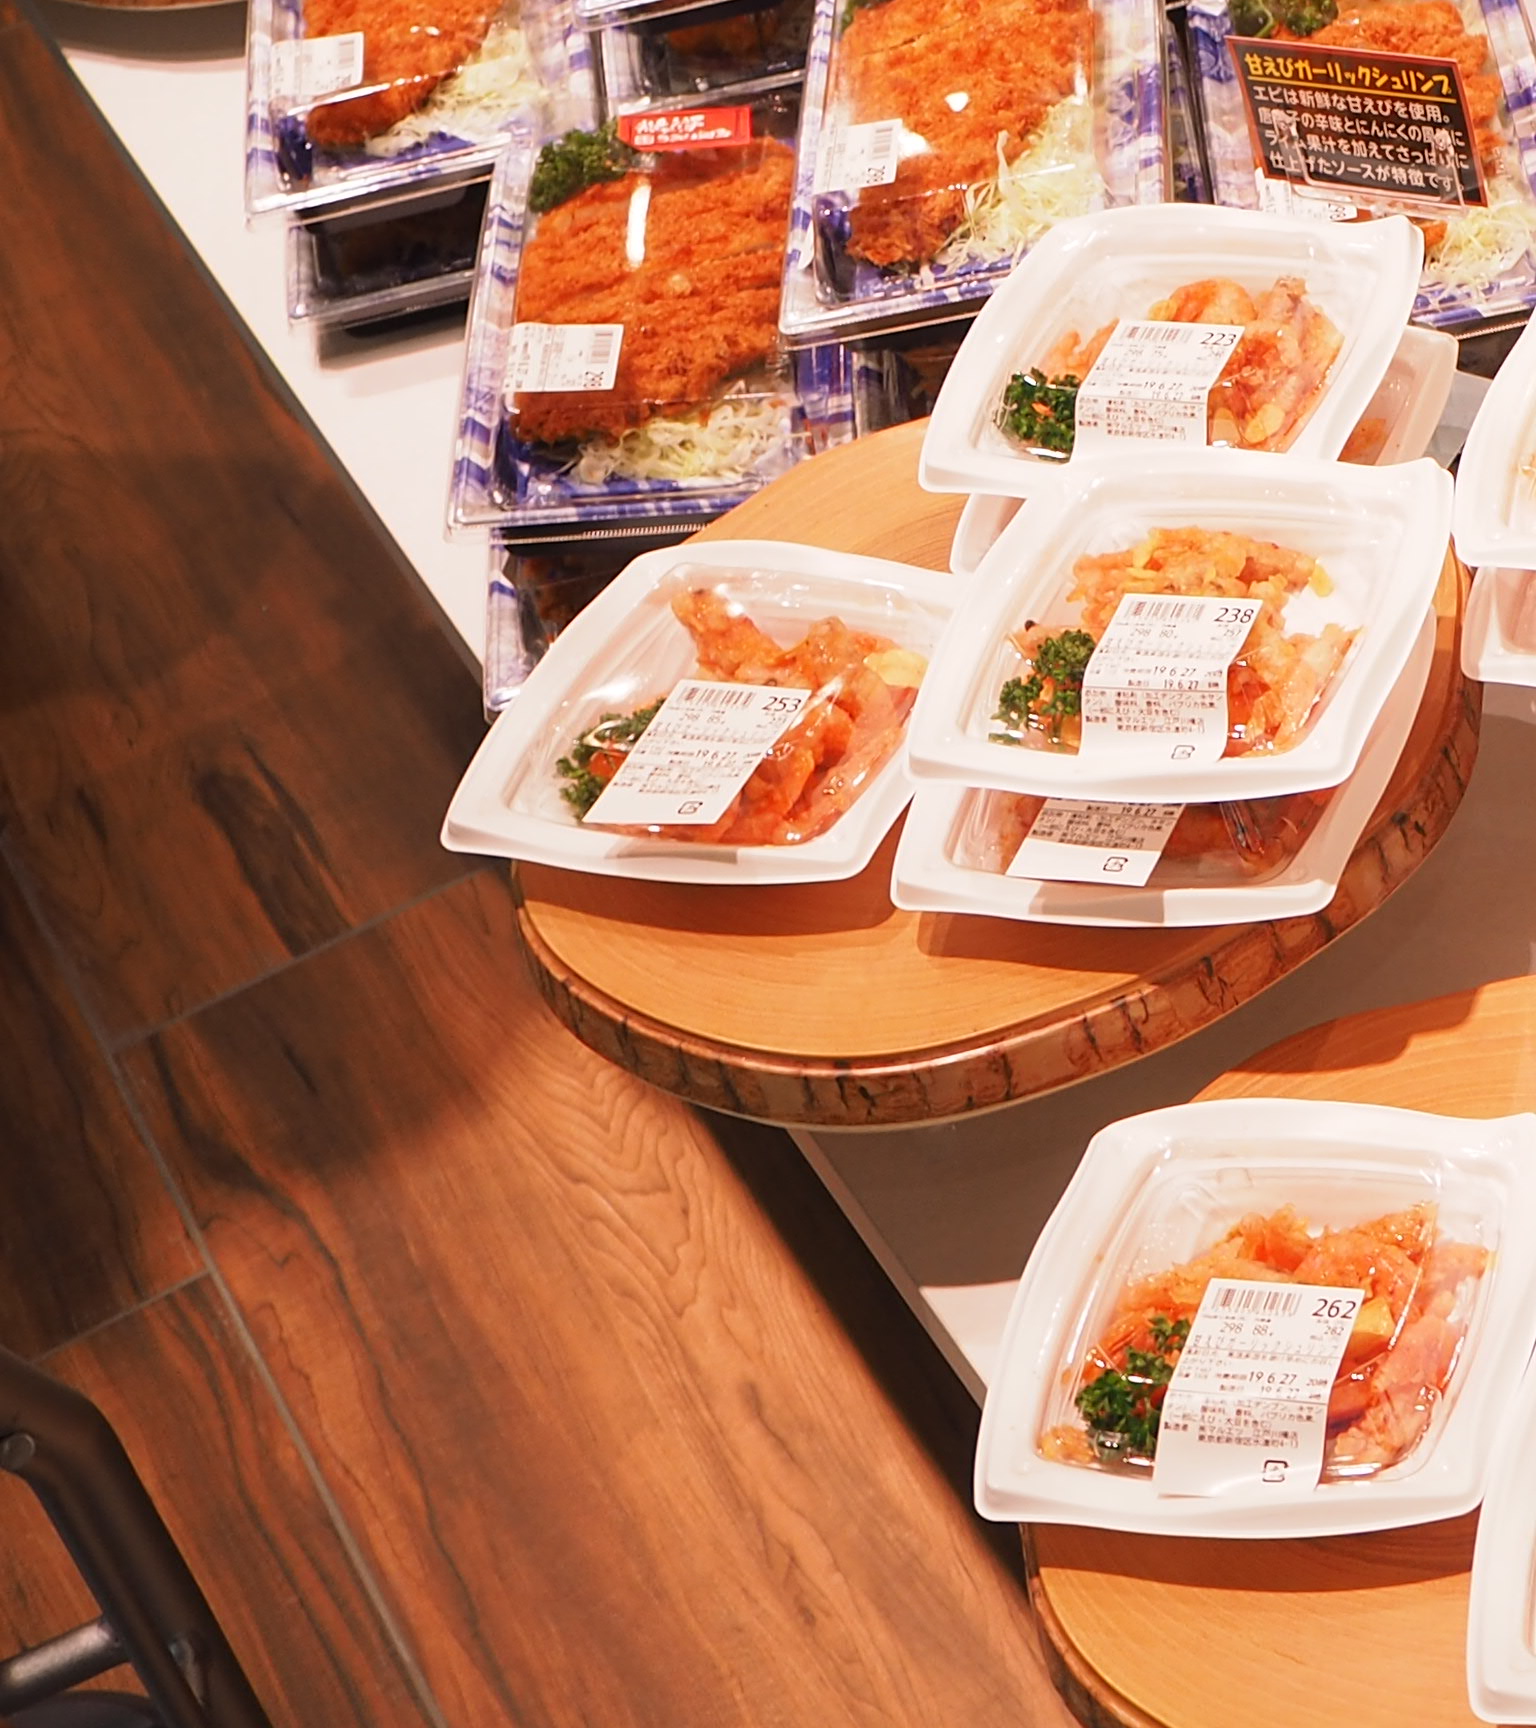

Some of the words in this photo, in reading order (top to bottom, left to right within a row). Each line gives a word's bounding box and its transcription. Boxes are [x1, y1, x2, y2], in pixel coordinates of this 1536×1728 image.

[1244, 52, 1453, 95] 甘えびガーリックシュリンプ
[1253, 85, 1451, 124] エビは新鮮な甘えびを使用。
[1269, 151, 1465, 192] 仕上げたソースが特徴です。
[1199, 331, 1238, 347] 223
[1213, 606, 1255, 625] 238
[761, 696, 802, 714] 253
[1311, 1297, 1357, 1320] 262
